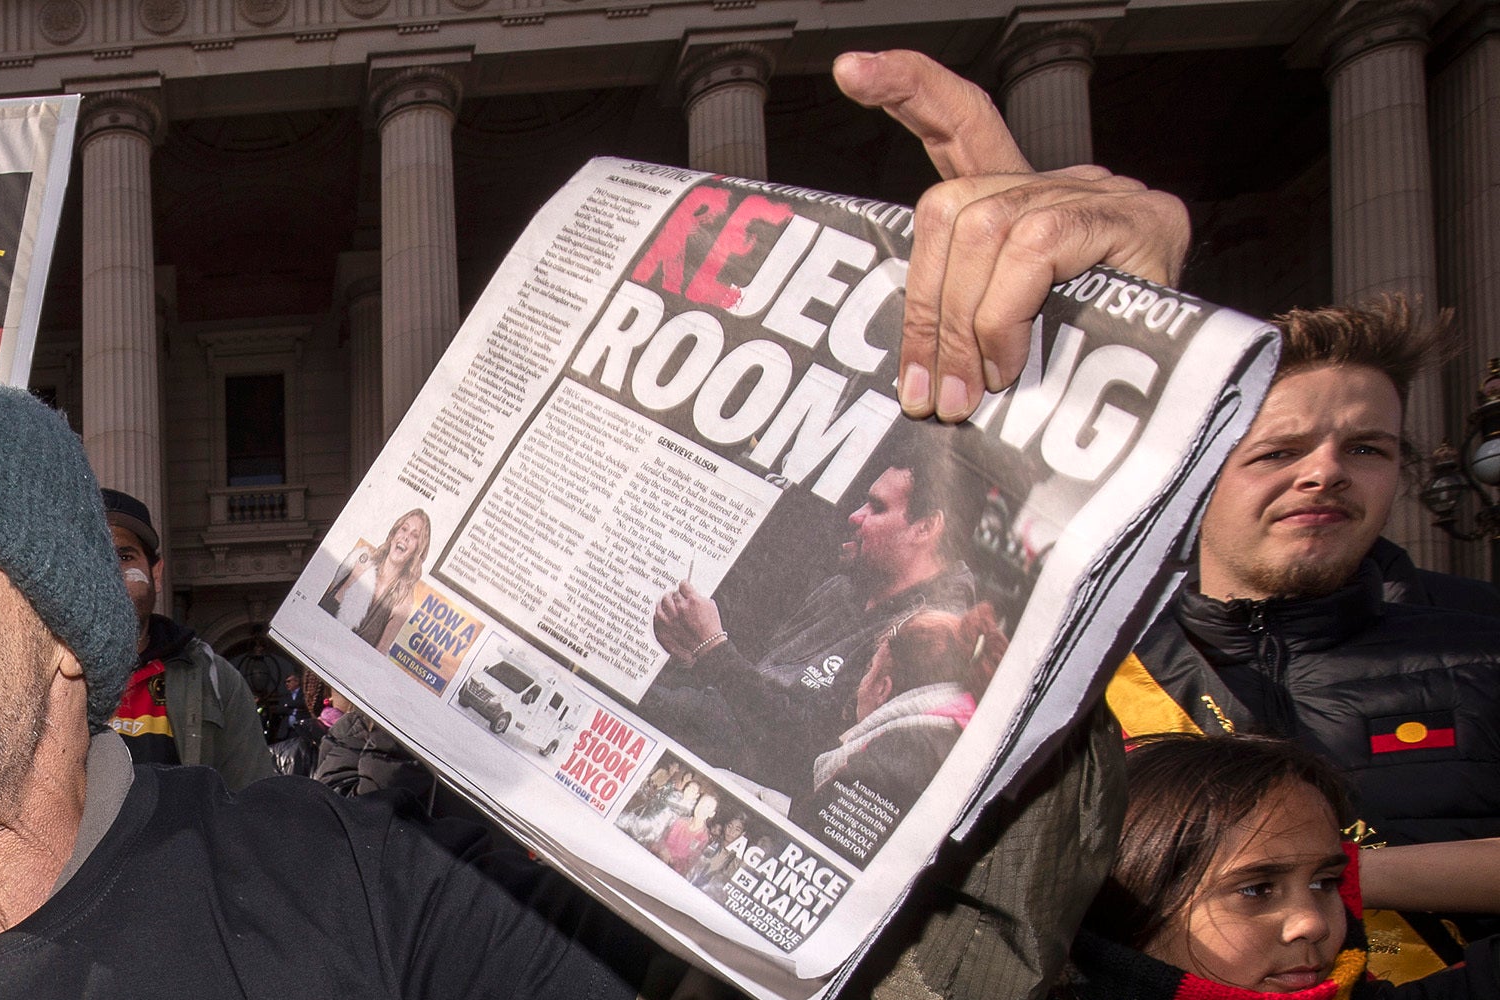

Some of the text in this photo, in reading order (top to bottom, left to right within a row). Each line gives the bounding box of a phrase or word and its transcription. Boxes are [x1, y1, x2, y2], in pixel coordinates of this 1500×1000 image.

[622, 163, 692, 182] SHOOTING
[819, 191, 914, 238] FACILITY
[1052, 270, 1201, 337] HOTSPOT
[632, 185, 1159, 481] REJECNG
[571, 280, 902, 505] ROOM
[658, 436, 719, 473] GENEVIEVE ALISON
[407, 609, 469, 658] FUNNY
[421, 594, 478, 643] NOW A
[537, 621, 568, 644] CONTINUED
[567, 641, 583, 656] PAGE
[396, 651, 436, 684] NAT BASS P3
[408, 632, 443, 669] GIRL
[573, 728, 636, 784] $100K
[590, 709, 646, 760] WIN A
[555, 771, 573, 787] NEW
[572, 784, 591, 801] CODE
[560, 749, 618, 805] JAYCO
[853, 780, 859, 788] A
[859, 785, 875, 798] man
[874, 793, 894, 811] holds
[828, 802, 877, 841] injecting room.
[834, 781, 893, 823] needle just 200m
[838, 797, 886, 832] away from the
[819, 809, 873, 850] Picture: NICOLE
[824, 826, 866, 858] GARMSTON
[723, 832, 834, 915] AGAINST
[737, 874, 752, 887] P5
[779, 842, 847, 900] RACE
[720, 882, 802, 945] FIGHT TO RESCUE
[725, 896, 795, 950] TRAPPED BOYS
[753, 880, 819, 935] RAIN
